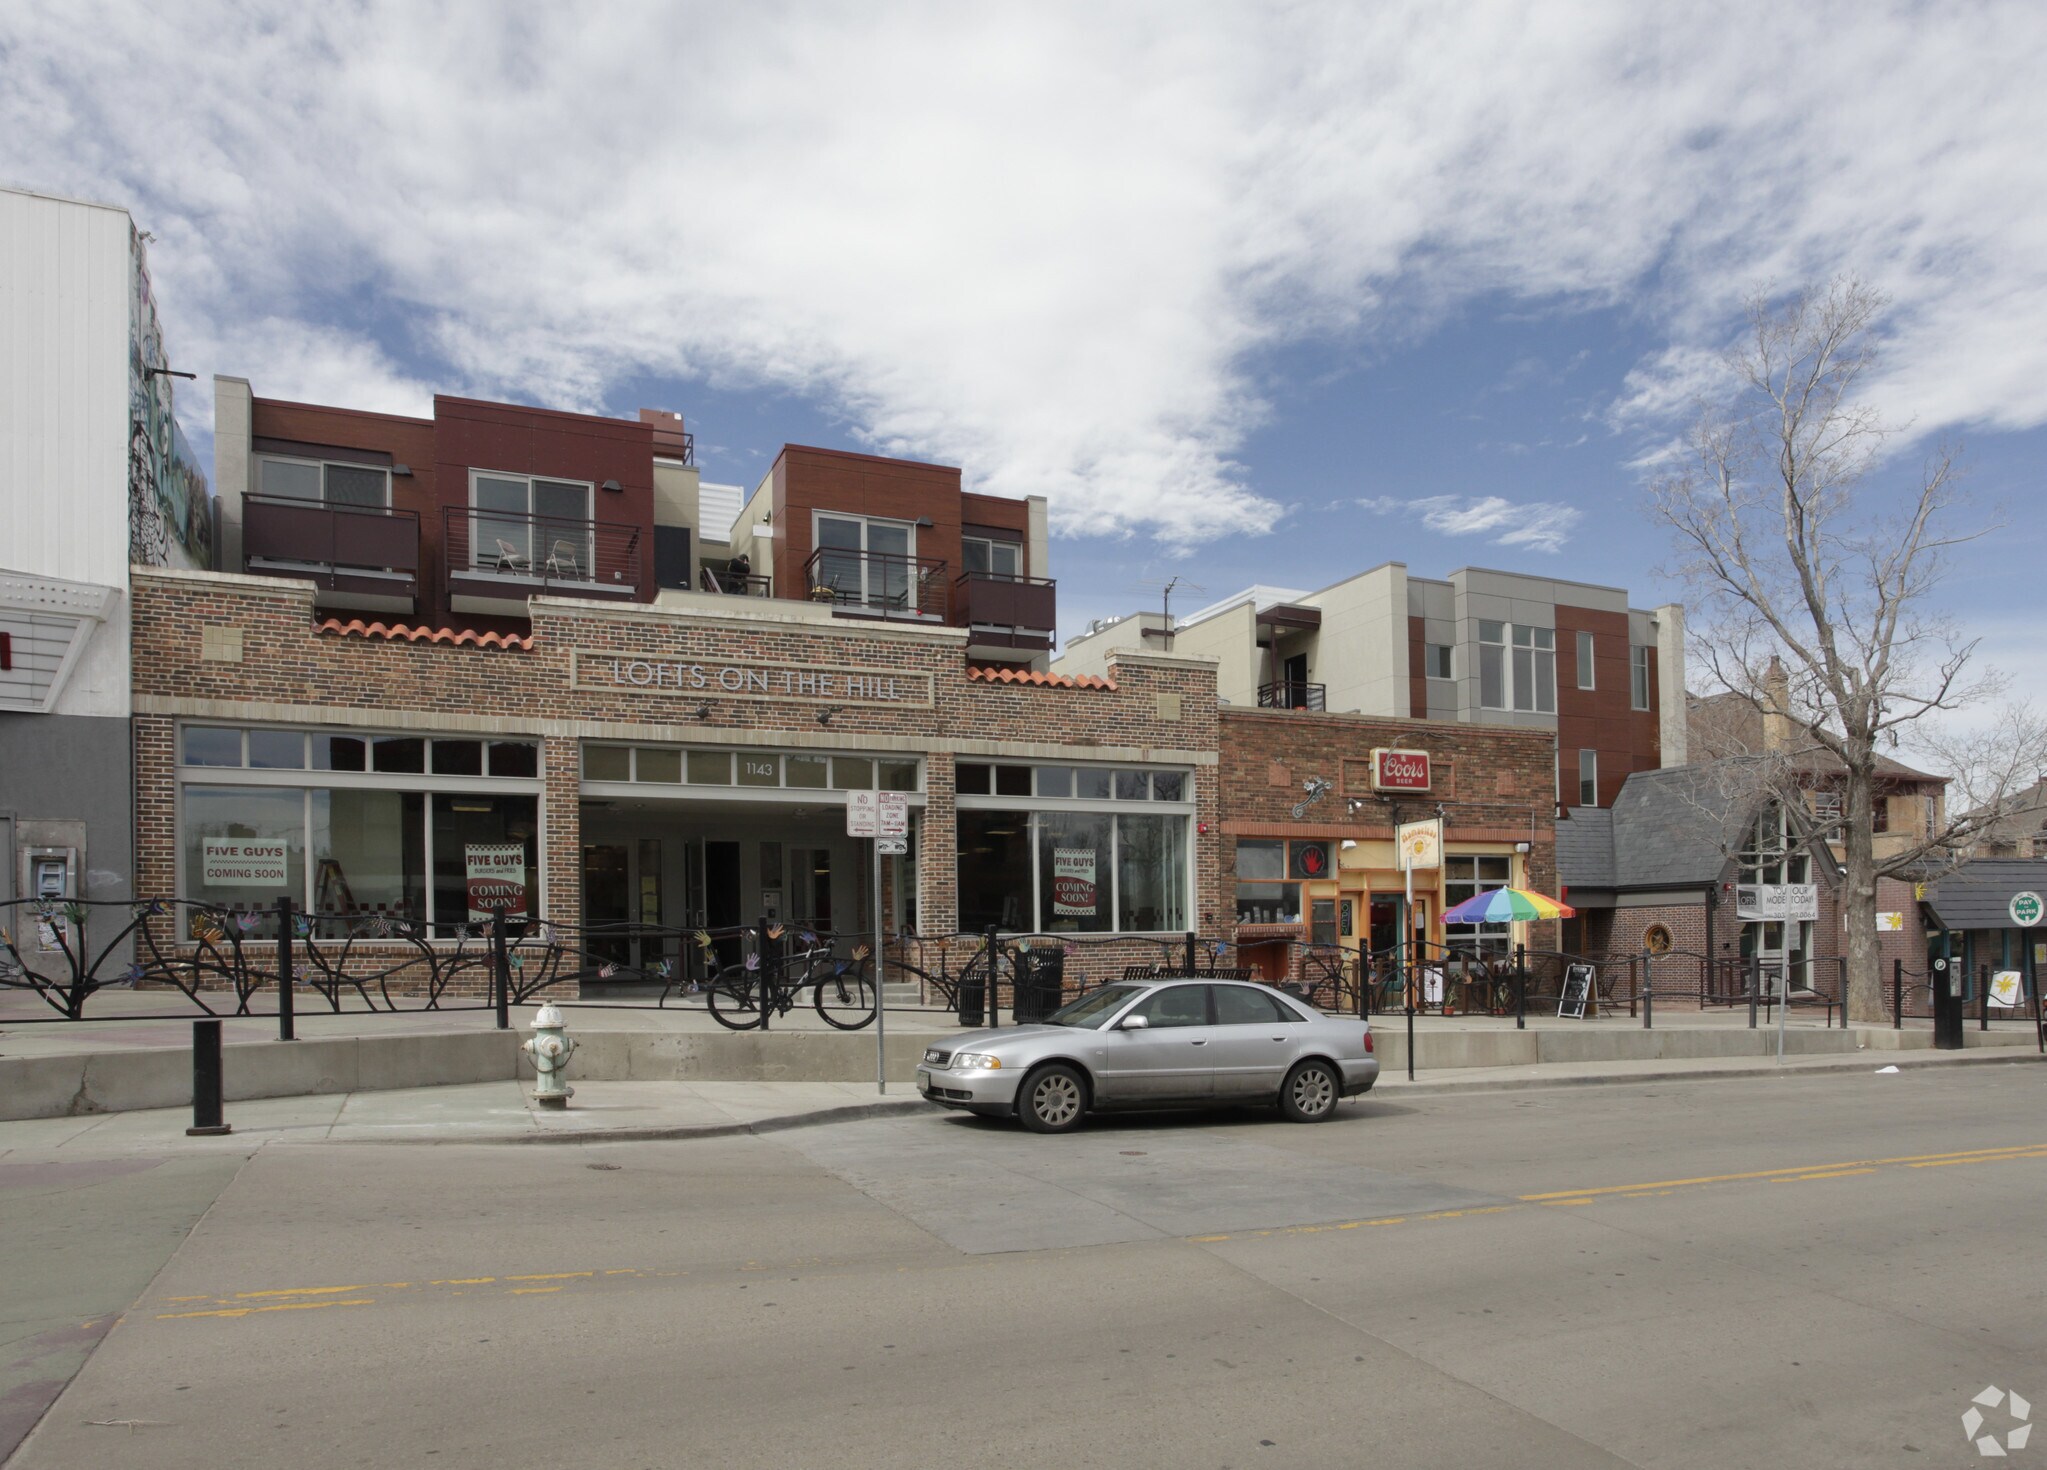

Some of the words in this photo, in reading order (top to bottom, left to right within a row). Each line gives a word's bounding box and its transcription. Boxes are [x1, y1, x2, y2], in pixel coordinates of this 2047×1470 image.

[614, 660, 706, 688] LOFTS
[719, 667, 768, 692] ON
[782, 671, 833, 696] THE
[847, 675, 900, 699] HILL
[746, 762, 773, 776] 1143
[1383, 757, 1425, 778] Coors
[857, 795, 868, 804] NO
[880, 793, 889, 803] NO
[206, 846, 239, 856] FIVE
[243, 847, 283, 857] GUYS
[467, 854, 490, 866] FIVE
[493, 854, 522, 866] GUYS
[1056, 857, 1072, 867] FIVE
[1073, 858, 1094, 868] GUYS
[207, 868, 252, 878] COMING
[254, 869, 284, 879] SOON
[469, 884, 523, 897] COMING
[1056, 882, 1094, 893] COMING
[1772, 886, 1788, 896] TOU
[1792, 886, 1809, 895] OUR
[477, 897, 516, 909] SOON!
[1061, 893, 1089, 903] SOON!
[1766, 895, 1788, 905] MODE
